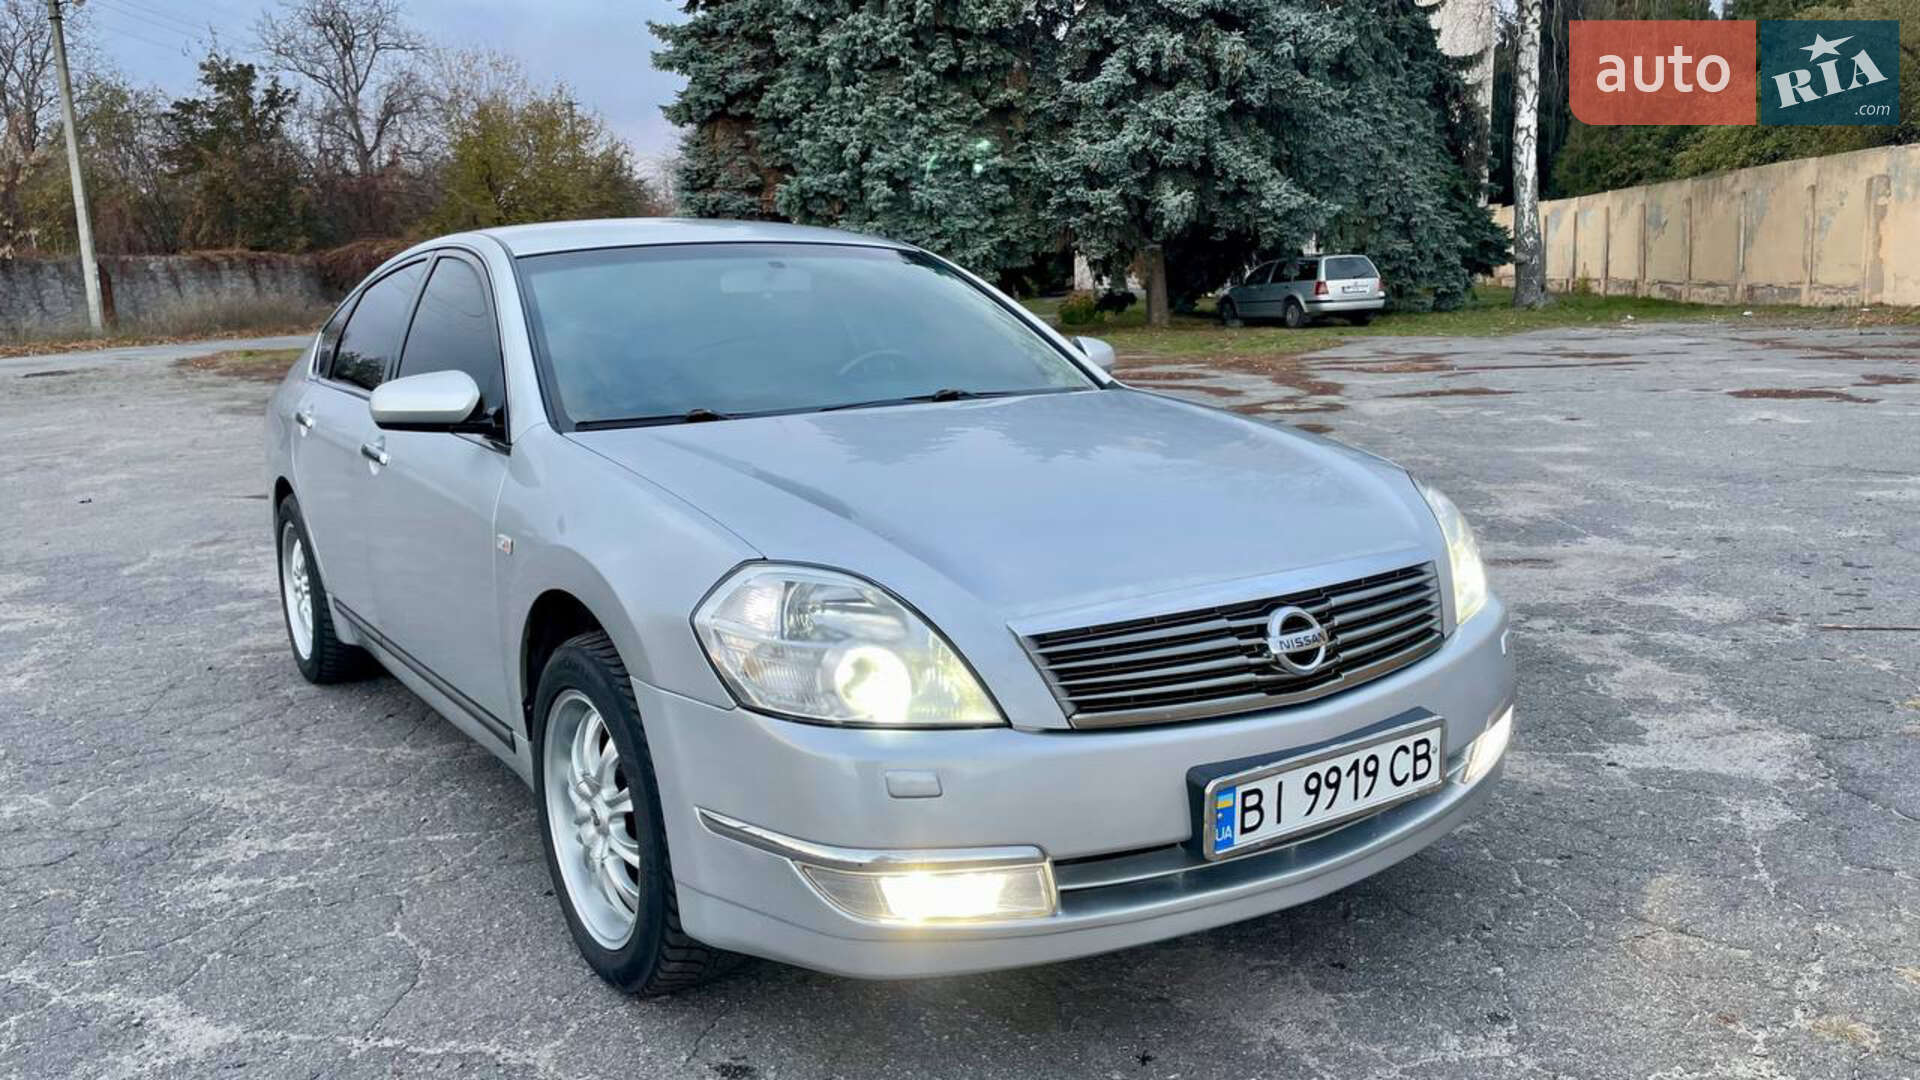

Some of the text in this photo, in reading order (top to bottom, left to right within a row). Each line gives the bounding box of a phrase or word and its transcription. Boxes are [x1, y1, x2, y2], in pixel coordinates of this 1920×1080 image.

[1240, 738, 1432, 835] BI 9919 CB
[1215, 827, 1233, 841] UA
